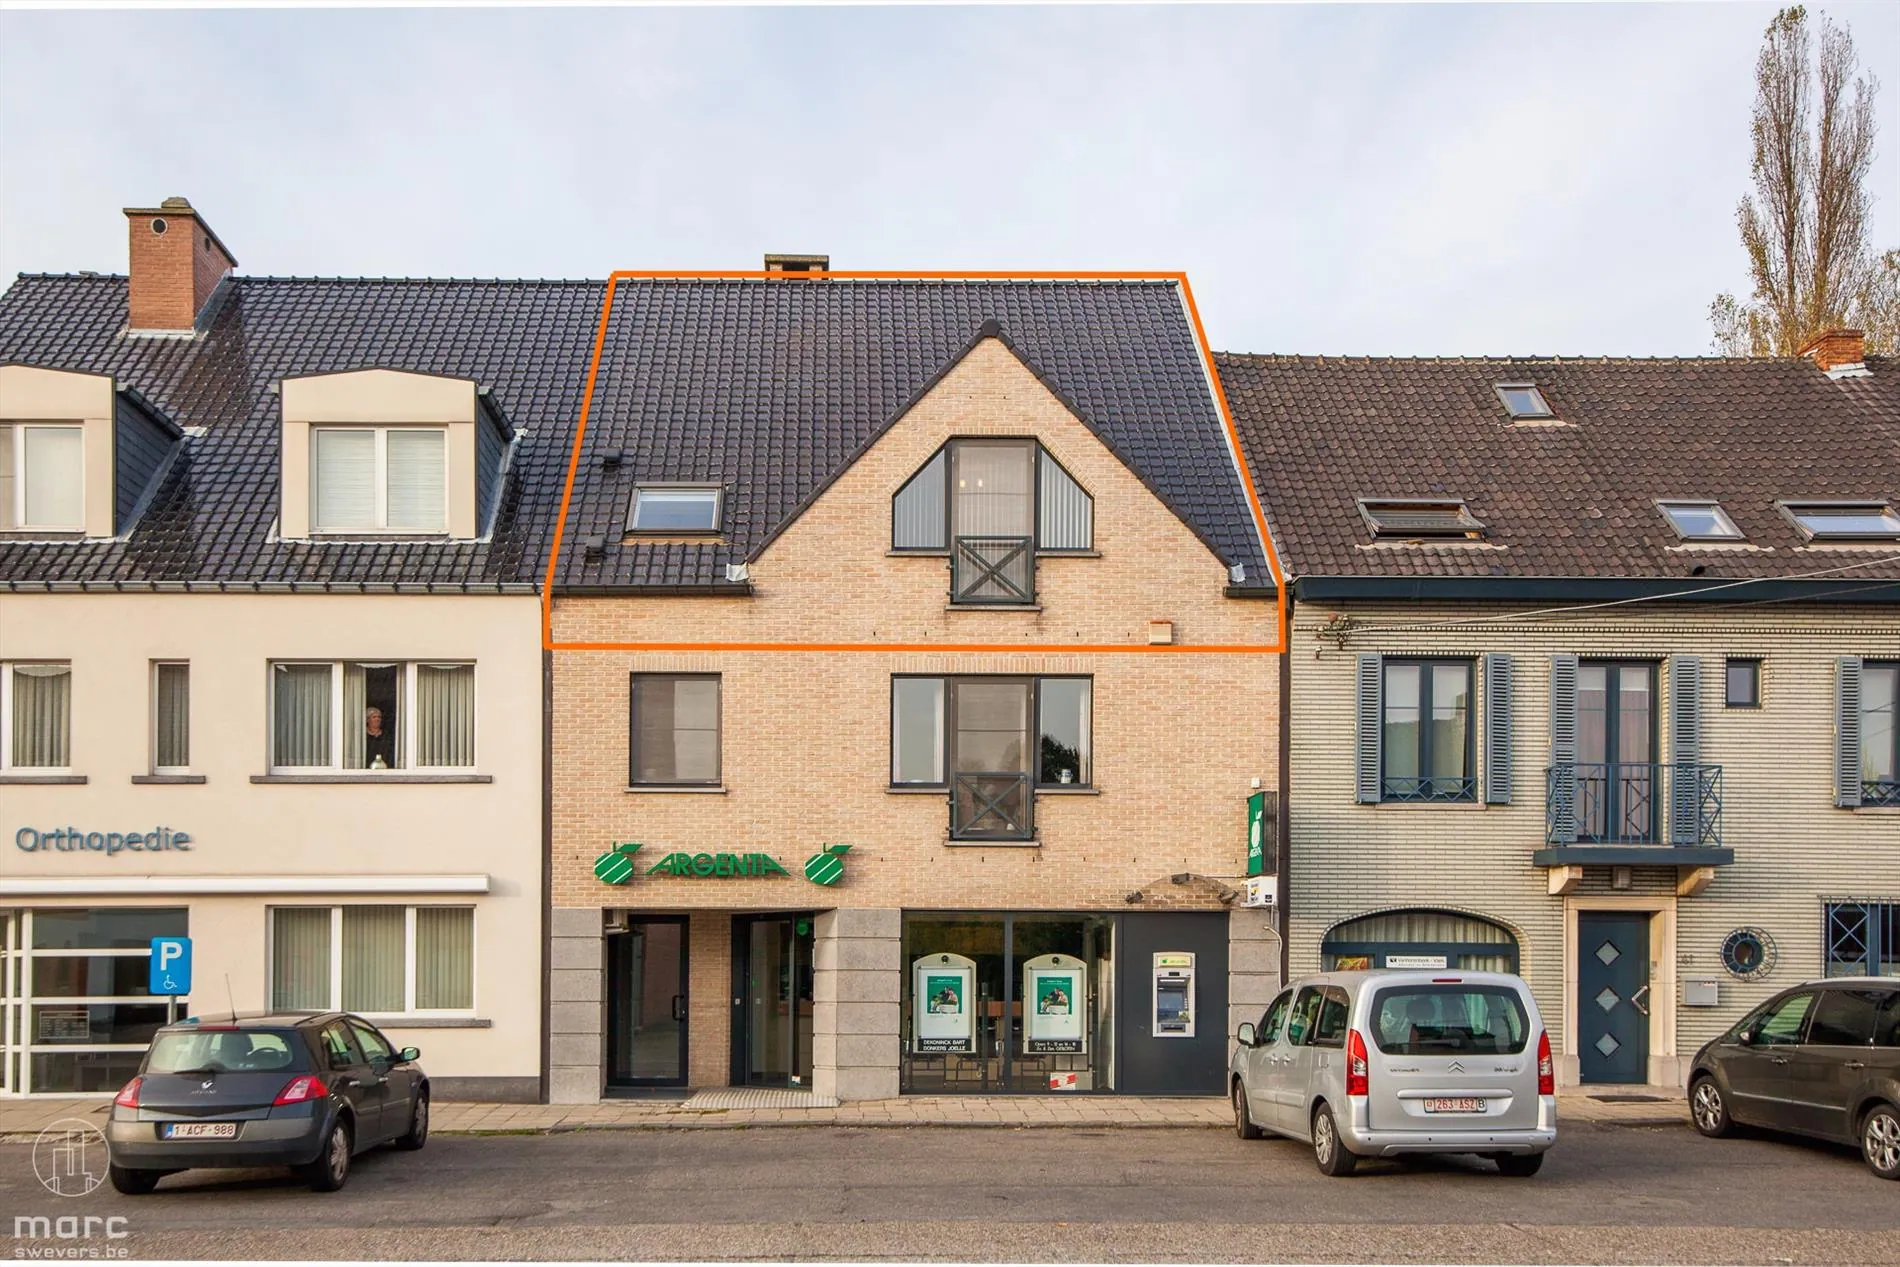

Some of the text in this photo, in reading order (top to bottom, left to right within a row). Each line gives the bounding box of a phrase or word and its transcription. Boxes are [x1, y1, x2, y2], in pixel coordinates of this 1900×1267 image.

[16, 826, 191, 856] Orthopedie
[646, 853, 792, 877] ARGENTA
[160, 941, 183, 971] P
